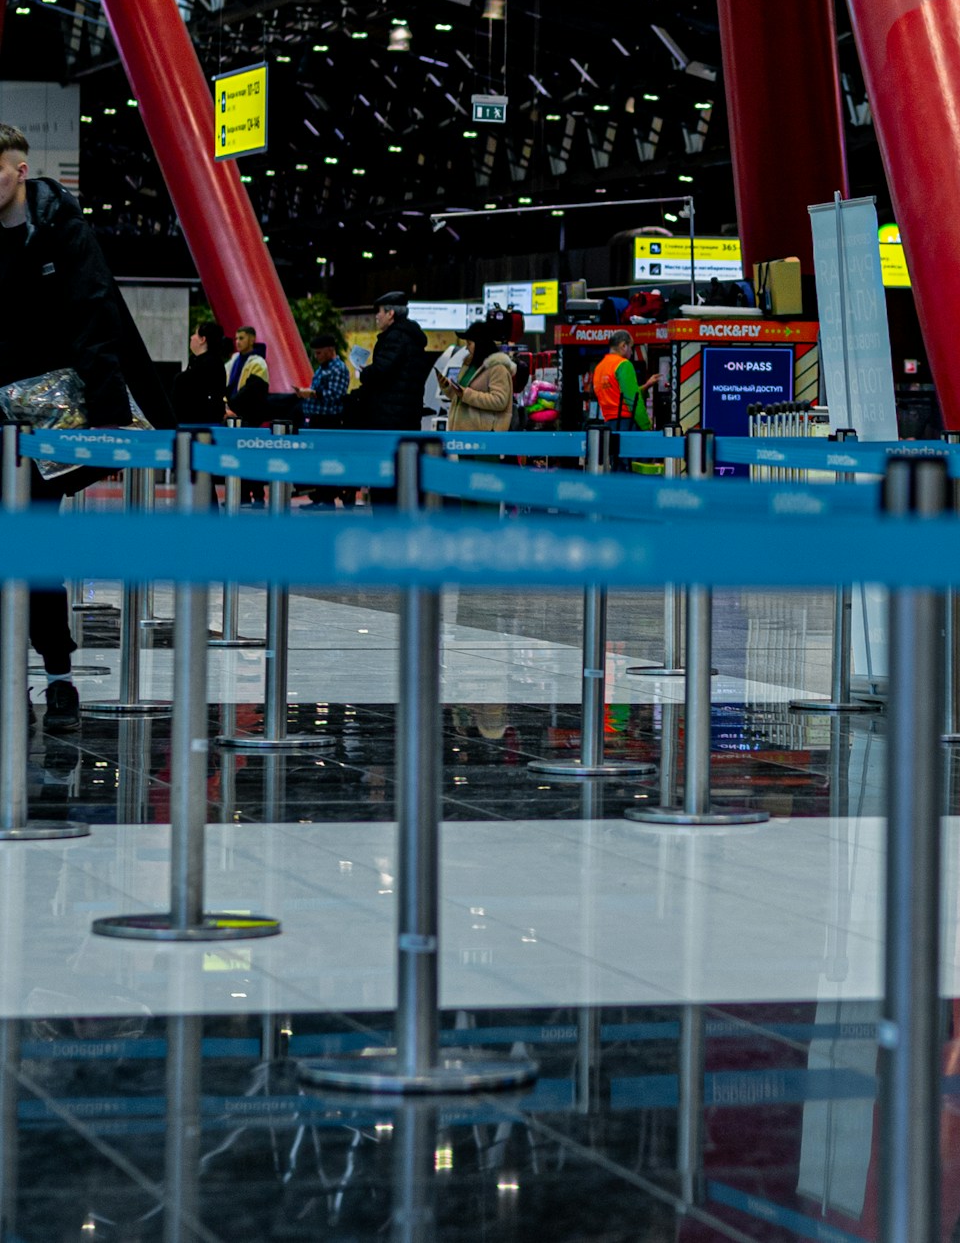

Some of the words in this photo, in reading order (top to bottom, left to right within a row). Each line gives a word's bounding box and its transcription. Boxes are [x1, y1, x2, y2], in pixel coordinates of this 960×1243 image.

[722, 244, 737, 252] 365
[700, 324, 761, 337] PACK&FLY
[670, 344, 678, 422] BAGGAGE
[712, 384, 755, 392] МОБИЛЬНЫЙ
[756, 385, 783, 393] ДОСТУП
[721, 393, 727, 401] В
[237, 437, 292, 450] pobeda
